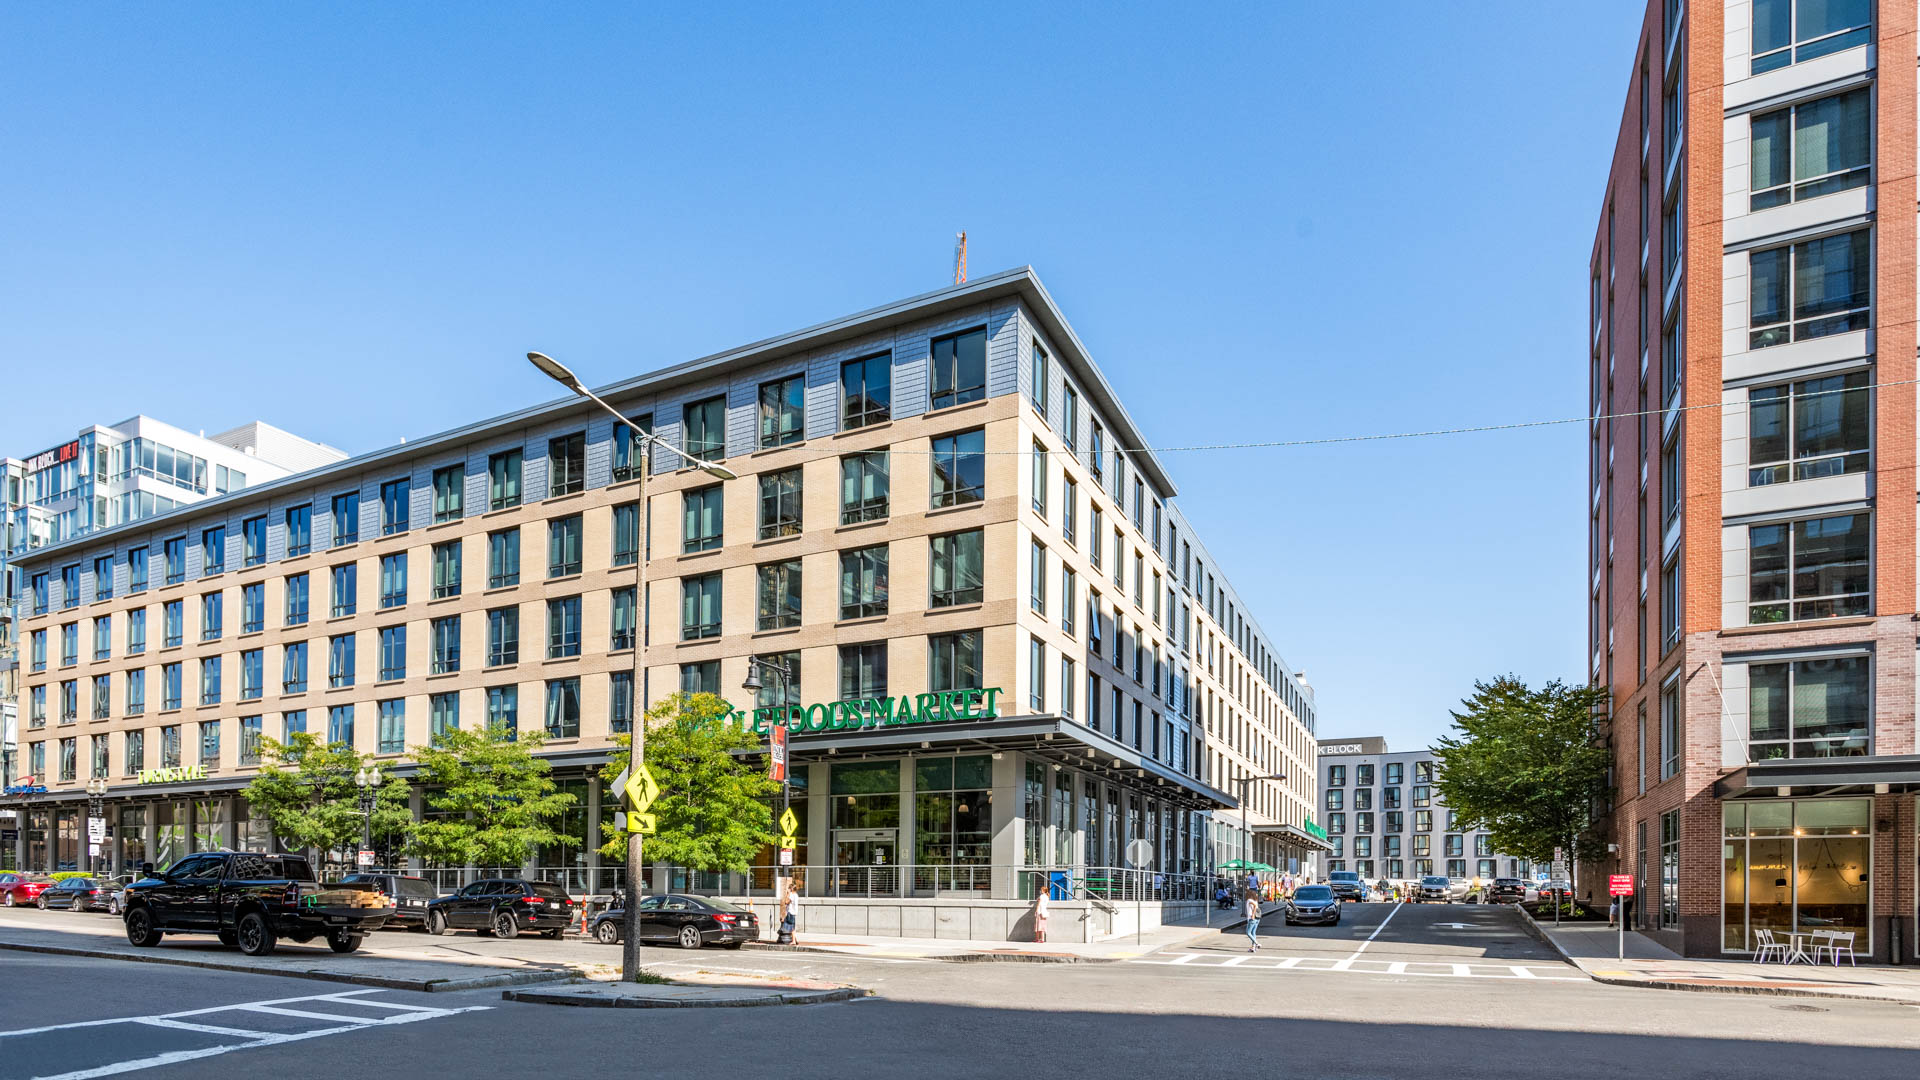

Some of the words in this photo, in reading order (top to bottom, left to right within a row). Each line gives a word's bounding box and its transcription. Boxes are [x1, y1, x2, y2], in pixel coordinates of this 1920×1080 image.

[60, 445, 71, 462] LIVE
[72, 442, 78, 457] IT
[771, 699, 865, 734] FOODS
[868, 687, 1004, 727] MARKET
[1327, 744, 1361, 754] BLOCK
[136, 764, 208, 784] TURNSTYLE
